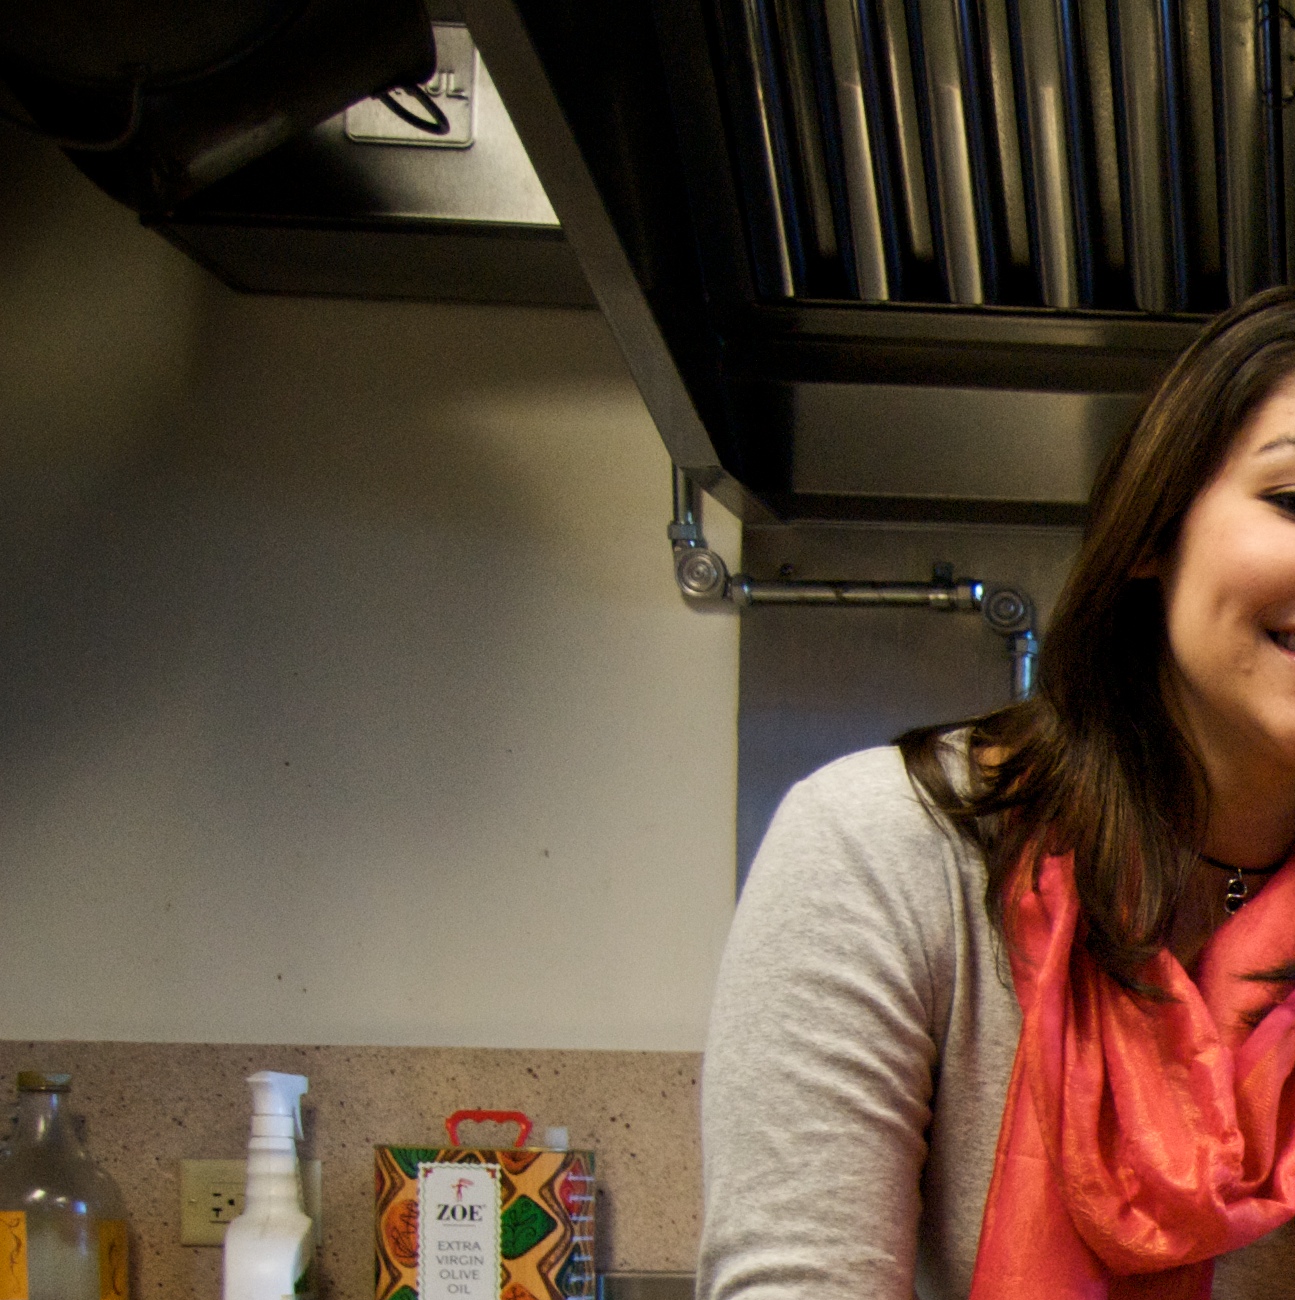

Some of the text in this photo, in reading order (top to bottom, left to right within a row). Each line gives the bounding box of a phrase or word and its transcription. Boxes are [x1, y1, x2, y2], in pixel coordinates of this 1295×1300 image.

[438, 1240, 481, 1251] EXTRA
[436, 1255, 484, 1266] VIRGIN
[439, 1268, 480, 1280] OLIVE
[447, 1283, 471, 1295] OIL
